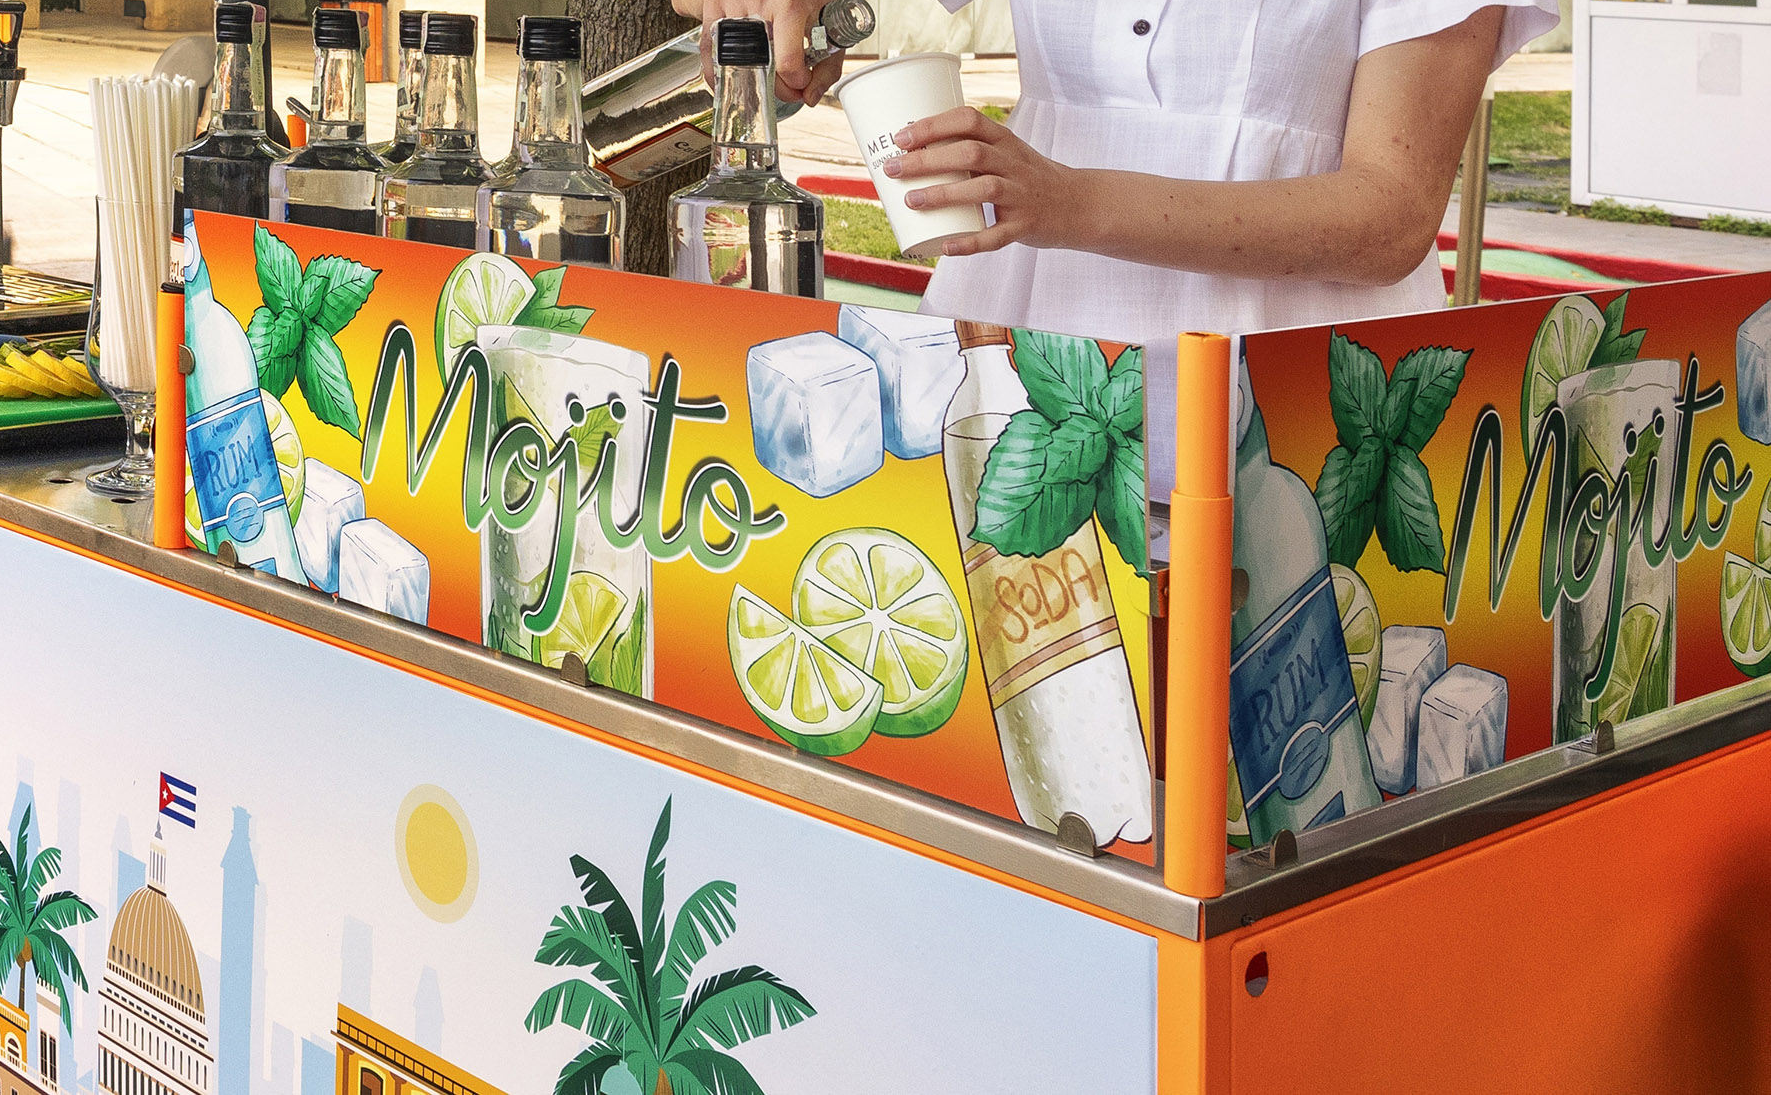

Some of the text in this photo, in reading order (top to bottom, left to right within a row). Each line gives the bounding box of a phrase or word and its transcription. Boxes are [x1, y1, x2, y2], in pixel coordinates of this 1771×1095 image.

[204, 435, 263, 497] RUM
[361, 324, 788, 635] Mojito
[1444, 357, 1754, 703] Mojito
[1249, 638, 1329, 755] RUM
